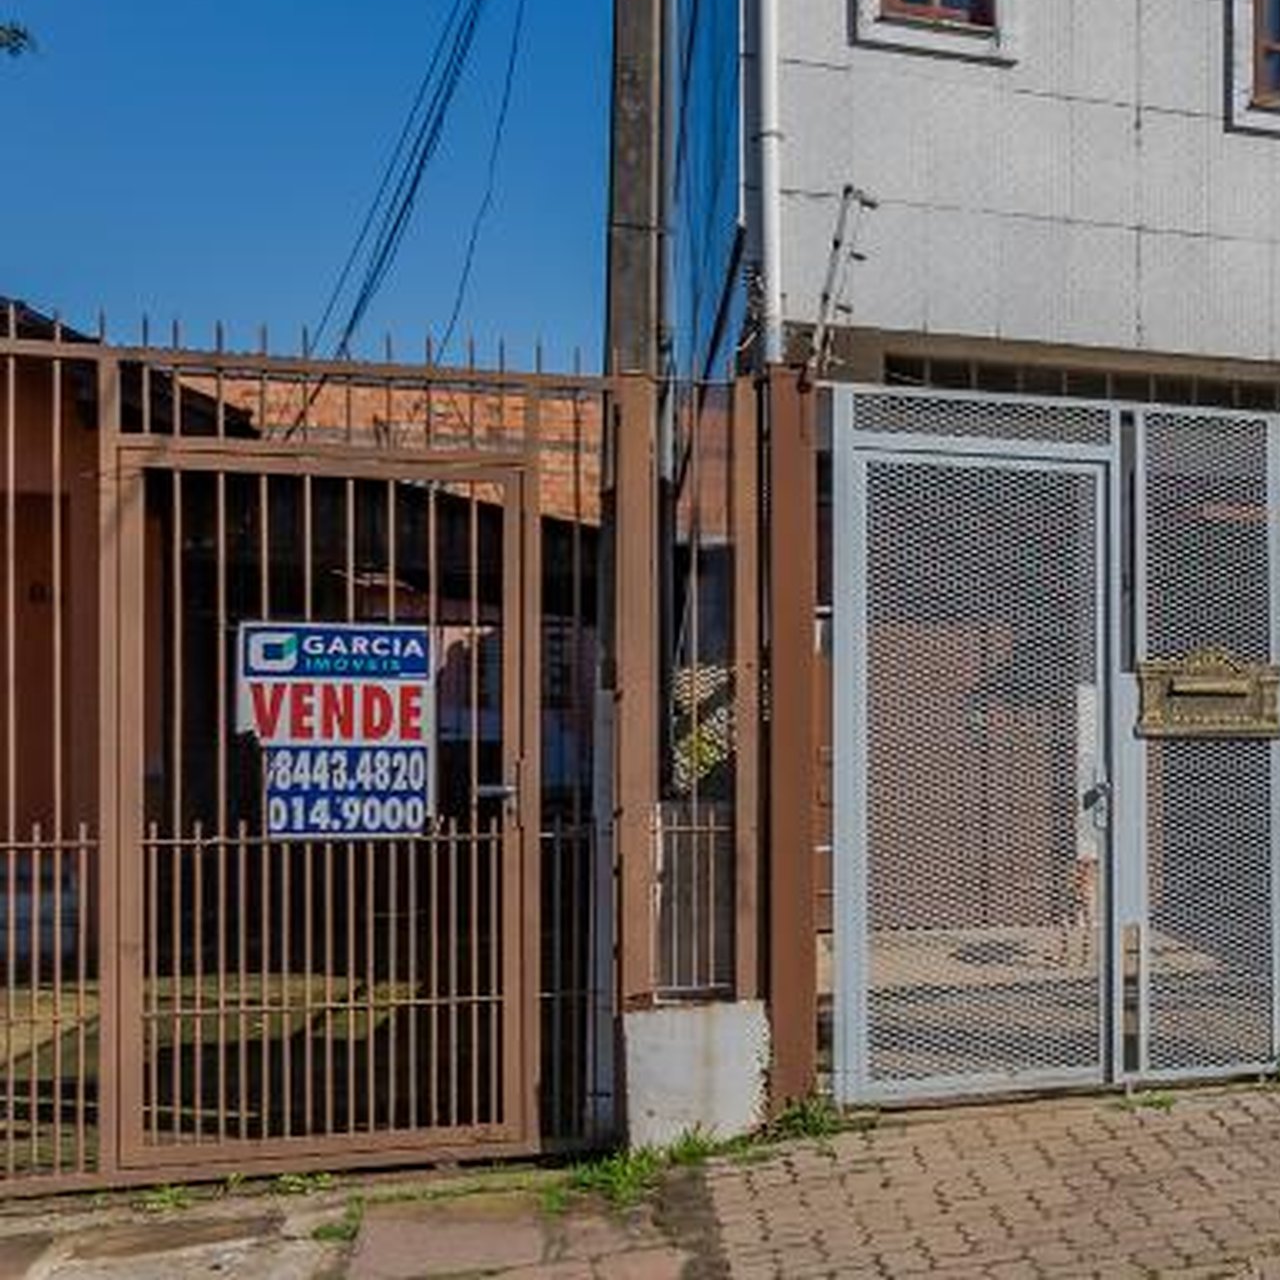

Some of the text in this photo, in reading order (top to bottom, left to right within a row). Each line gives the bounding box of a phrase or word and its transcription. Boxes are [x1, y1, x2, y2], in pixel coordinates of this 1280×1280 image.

[302, 635, 424, 658] GARCIA
[251, 682, 422, 739] VENDE
[267, 749, 424, 791] 8443.4820
